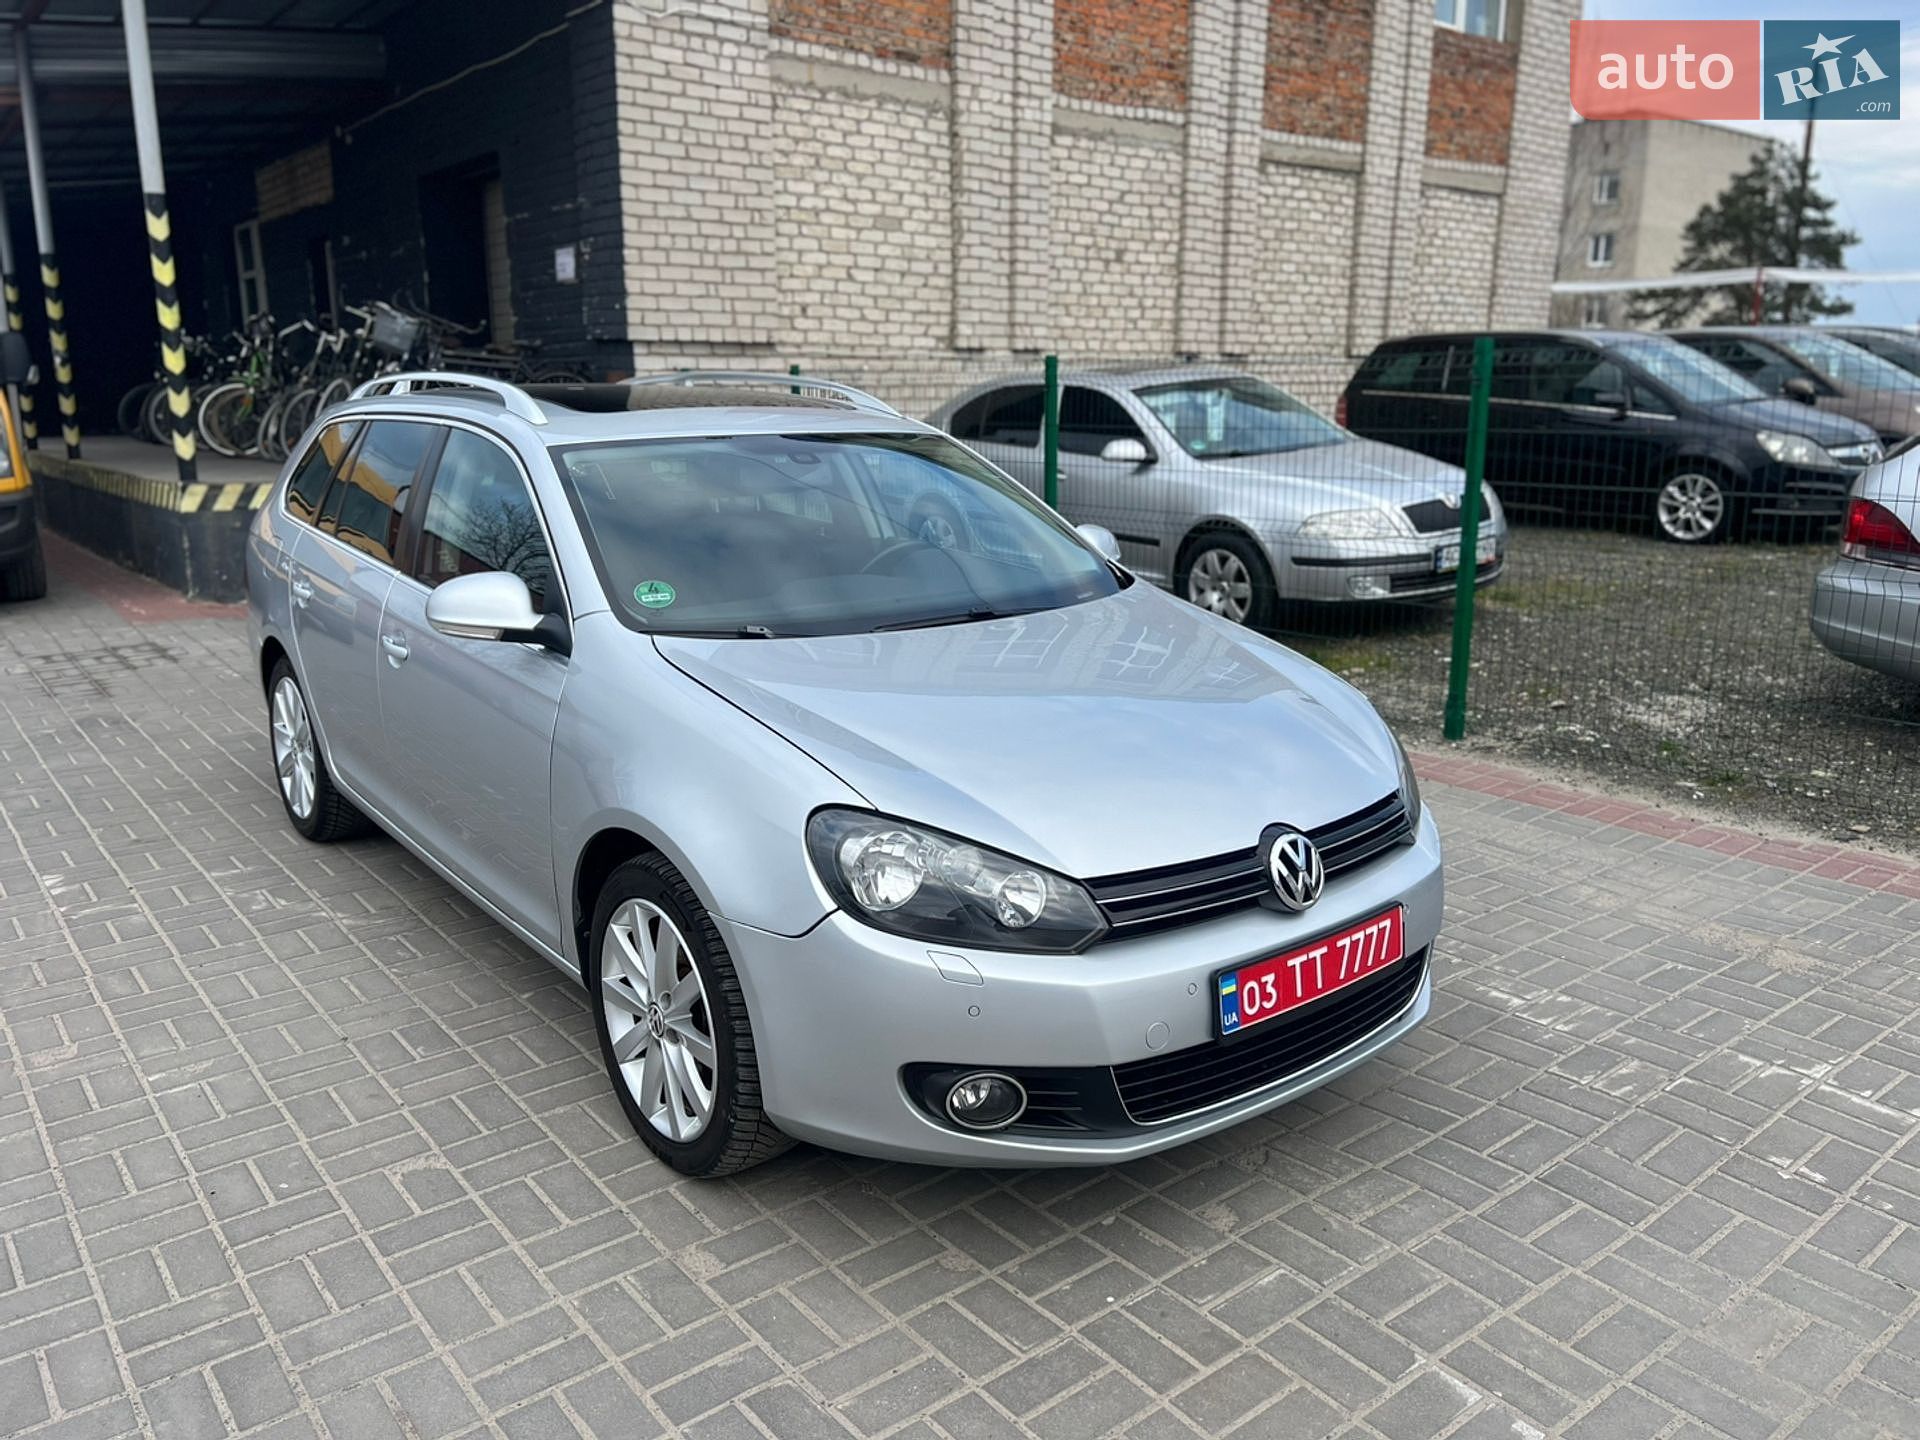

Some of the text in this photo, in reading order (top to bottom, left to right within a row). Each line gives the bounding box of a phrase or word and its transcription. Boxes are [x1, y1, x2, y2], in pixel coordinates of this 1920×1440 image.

[1242, 918, 1392, 1016] 03 TT 7777
[1224, 1011, 1239, 1026] UA
